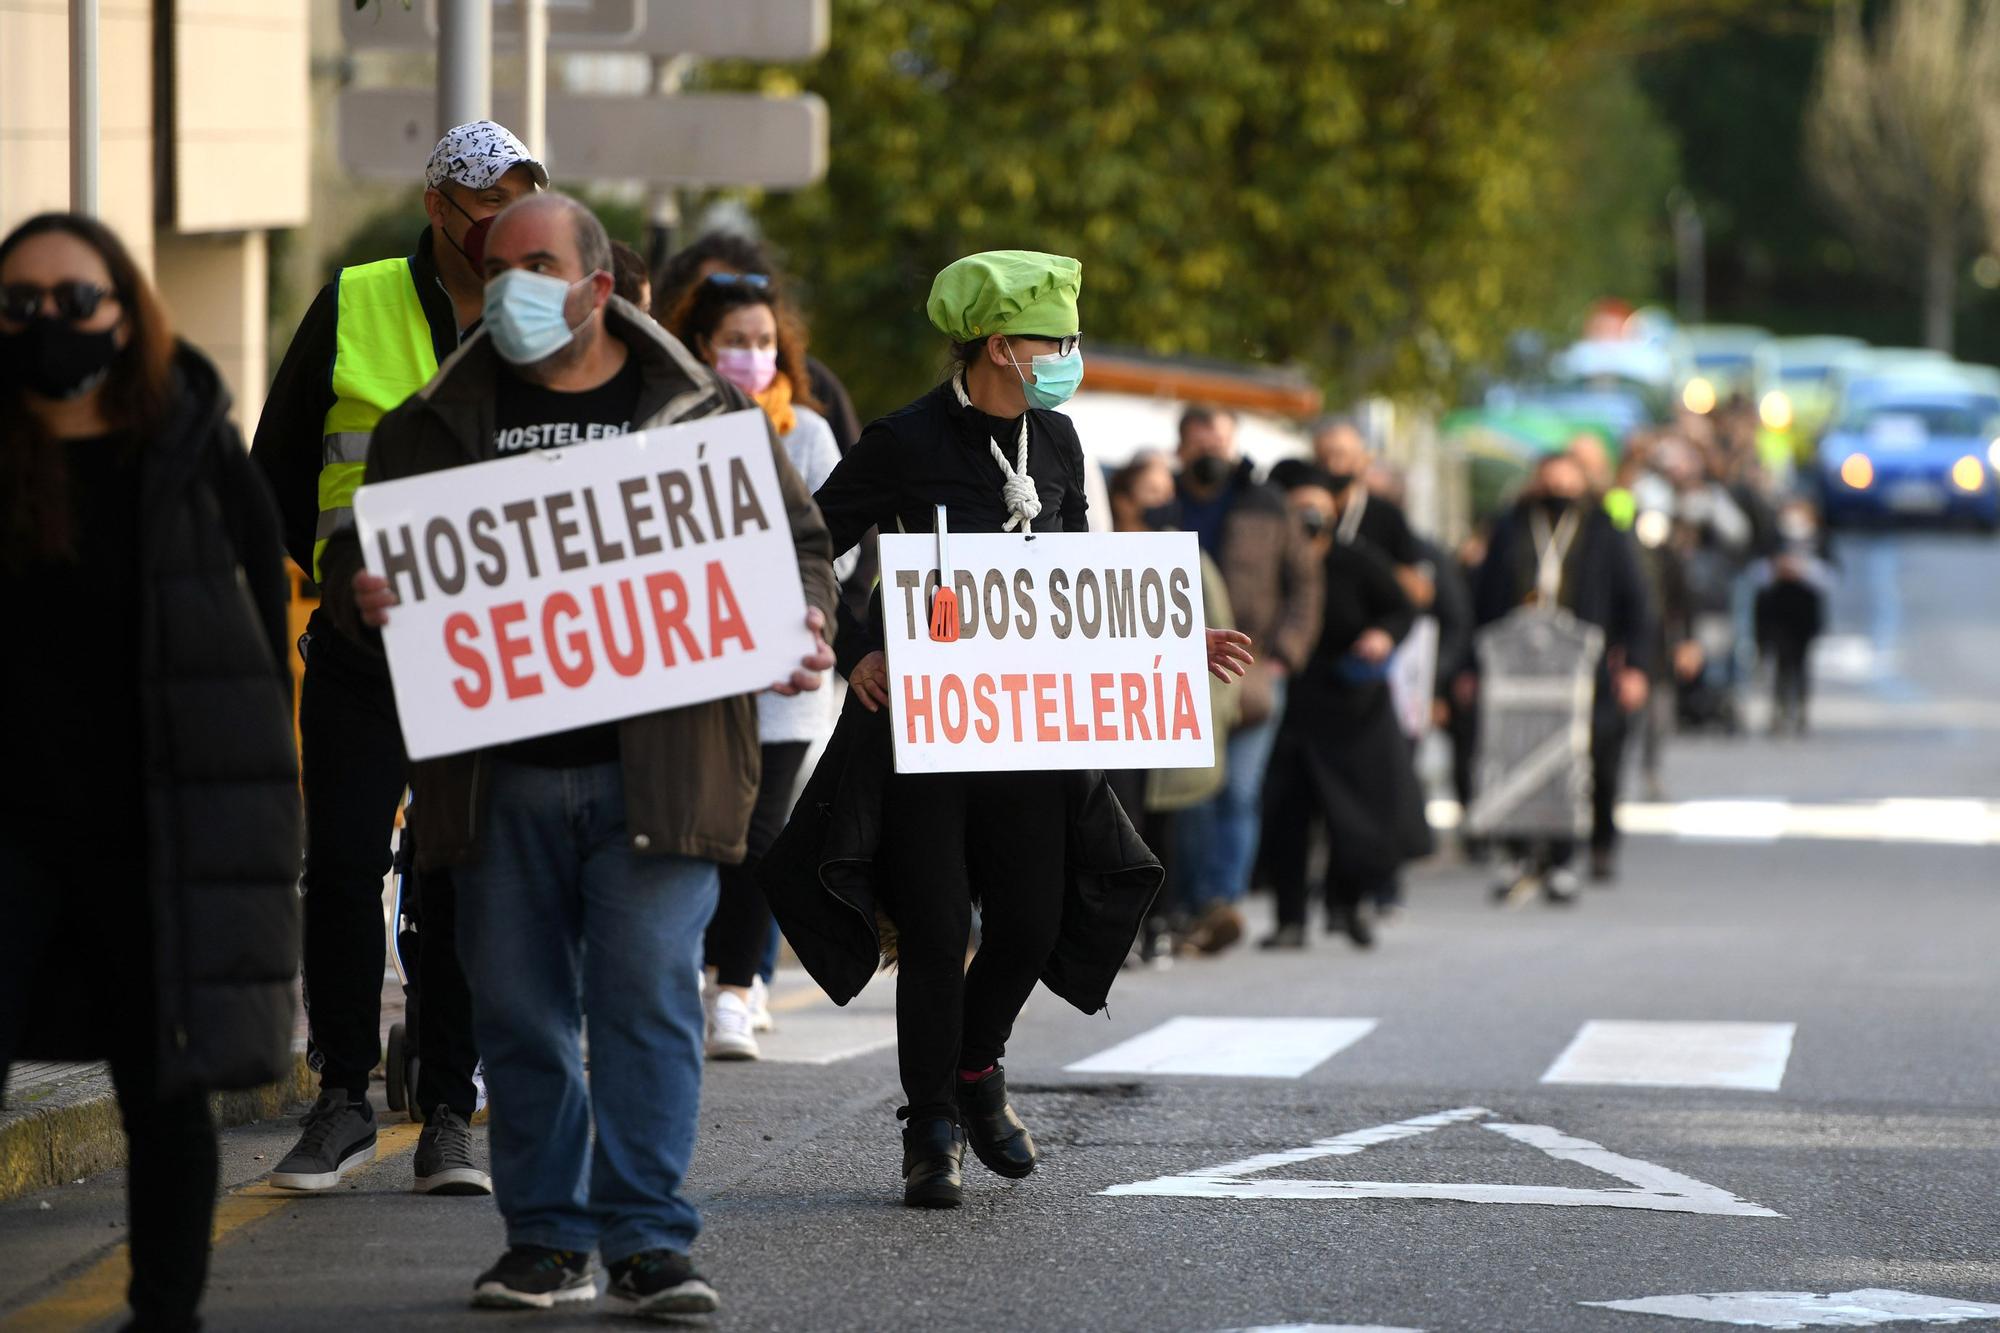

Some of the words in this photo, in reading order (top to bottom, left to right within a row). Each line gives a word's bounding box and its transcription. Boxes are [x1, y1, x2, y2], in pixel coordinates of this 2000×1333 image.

[377, 443, 771, 606] HOSTELERÍA
[443, 561, 755, 709] SEGURA
[1048, 568, 1193, 640] SOMOS
[903, 655, 1201, 744] HOSTELERÍA
